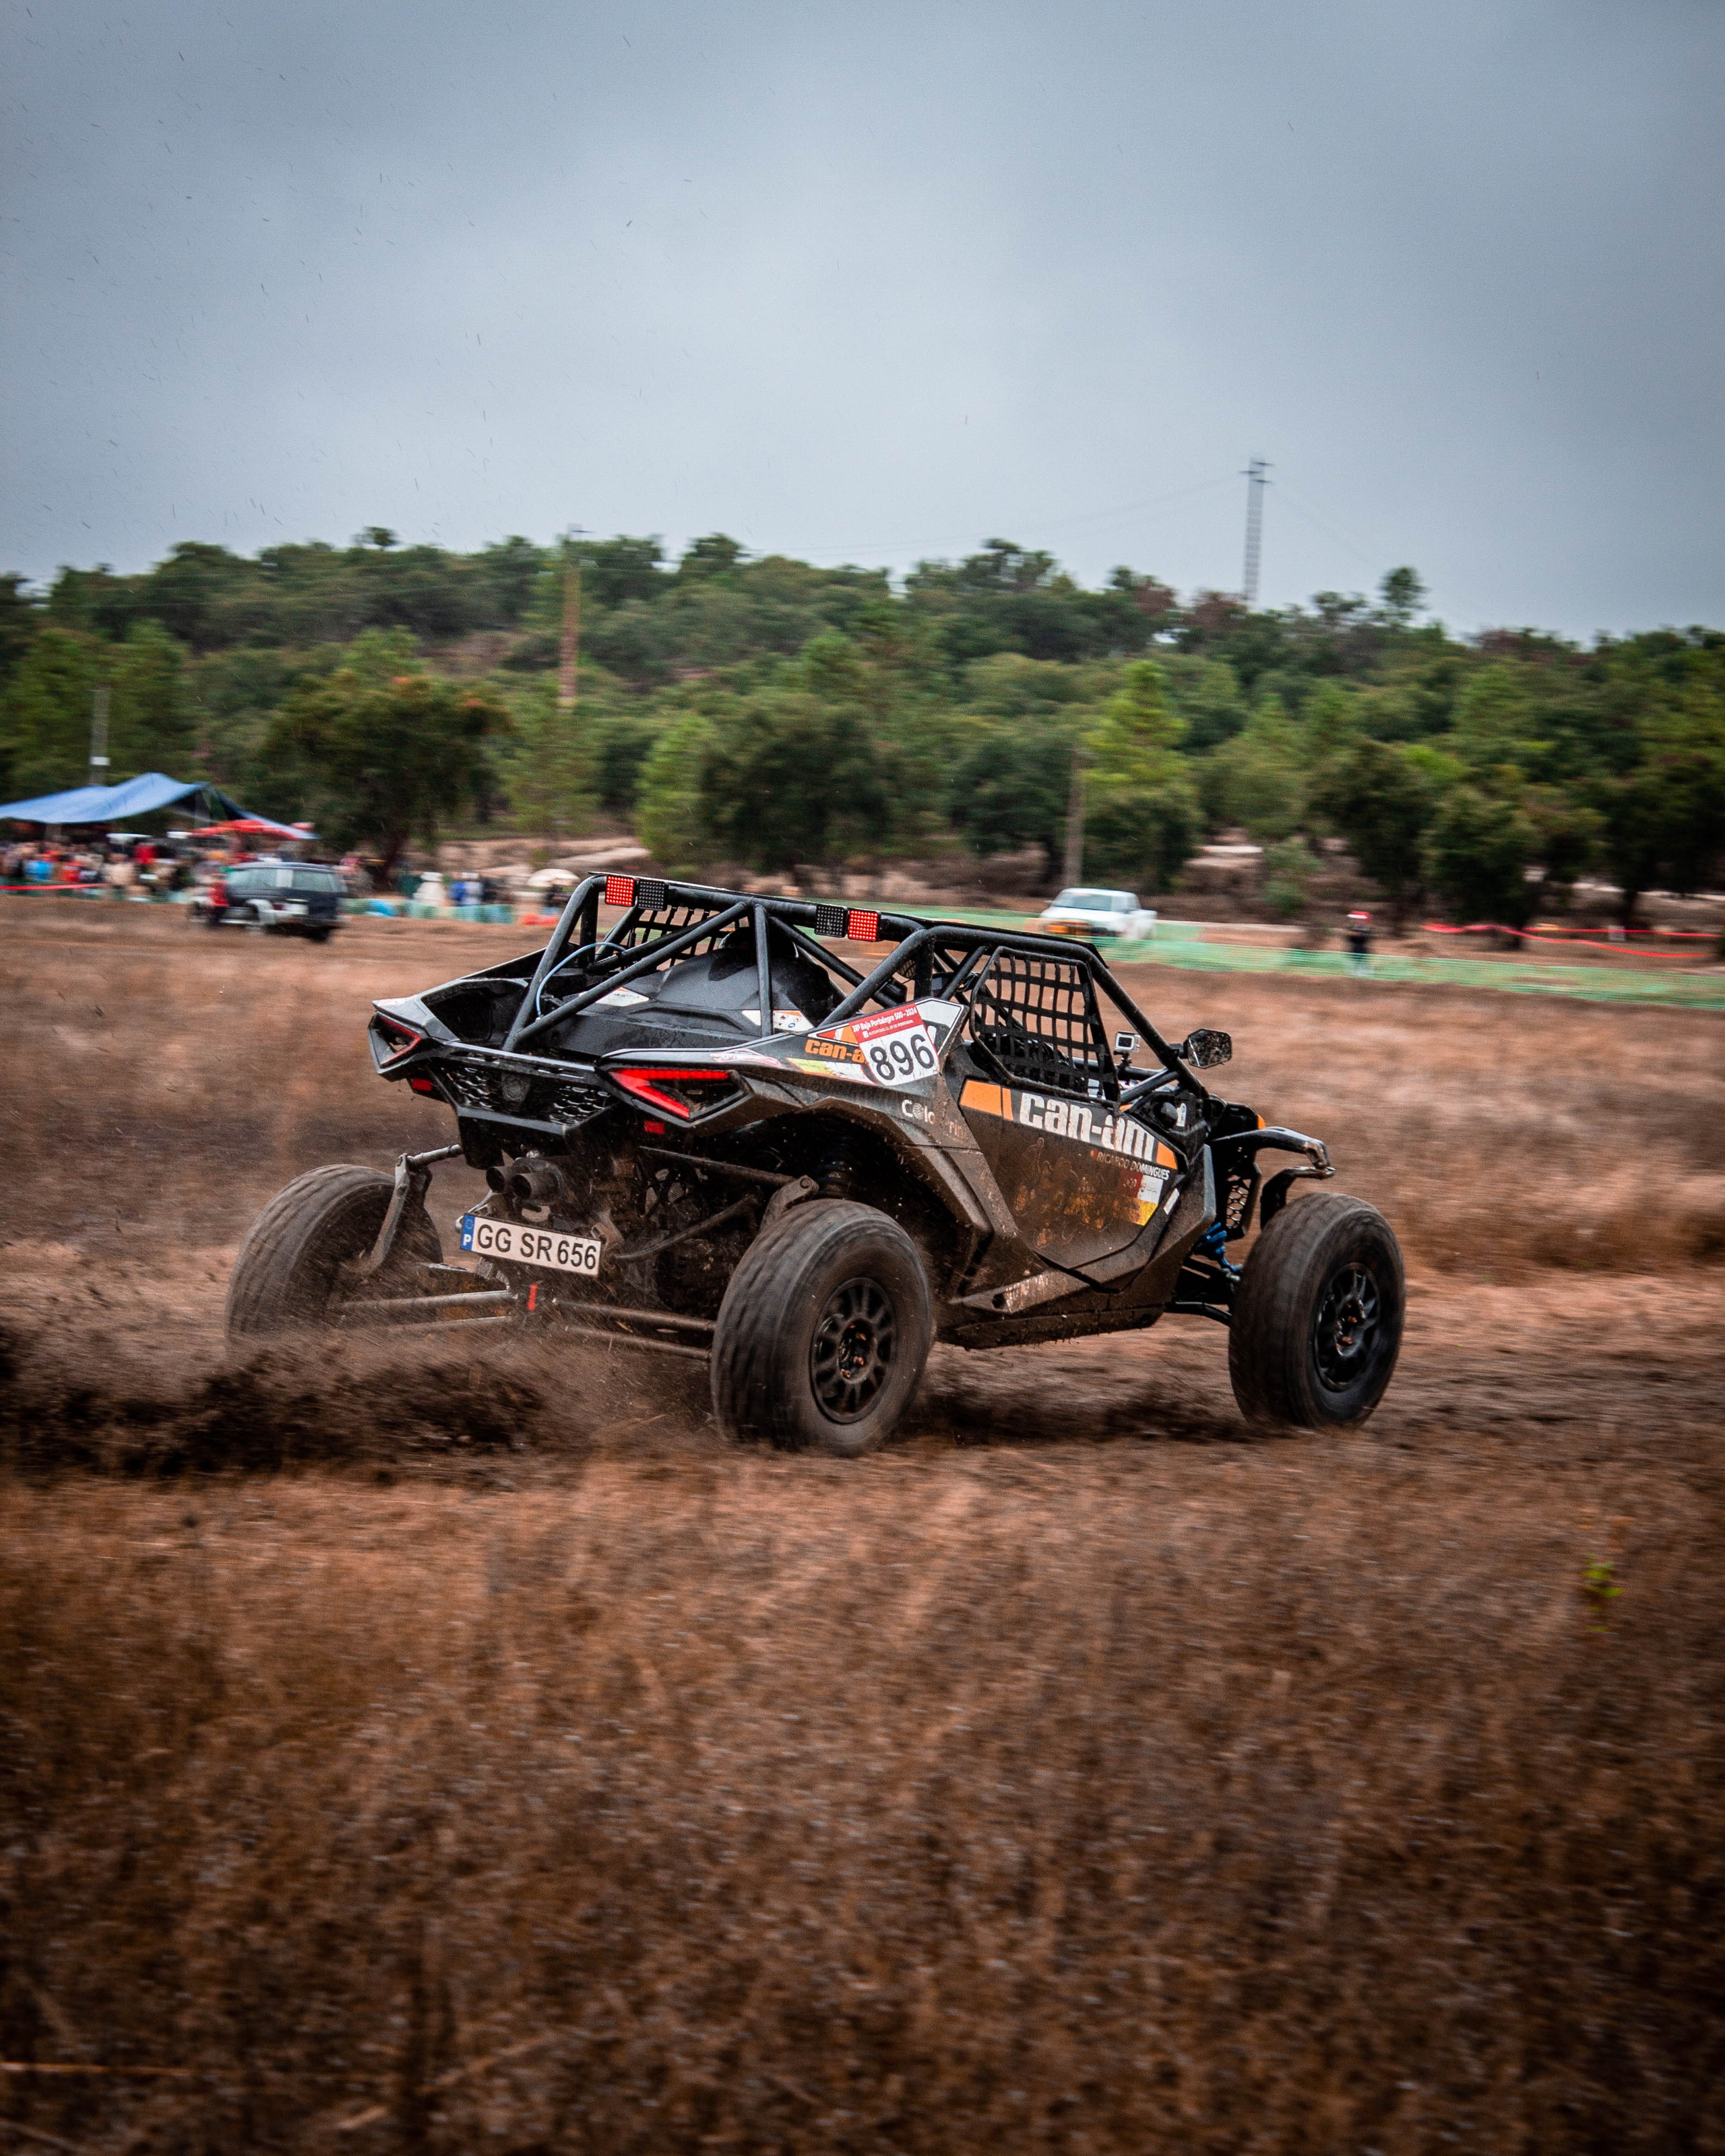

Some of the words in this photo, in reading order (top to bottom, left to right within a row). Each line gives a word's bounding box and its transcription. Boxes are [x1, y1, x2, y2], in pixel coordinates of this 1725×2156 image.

[860, 1020, 871, 1030] Baja
[871, 1015, 894, 1027] Portalegre
[805, 1039, 866, 1063] can-a
[870, 1034, 935, 1080] 896
[1020, 1092, 1155, 1162] can-am
[1130, 1160, 1170, 1180] DOMINGUES
[463, 1234, 472, 1246] P
[477, 1224, 511, 1253] GG
[520, 1232, 553, 1262] SR
[557, 1240, 596, 1269] 656
